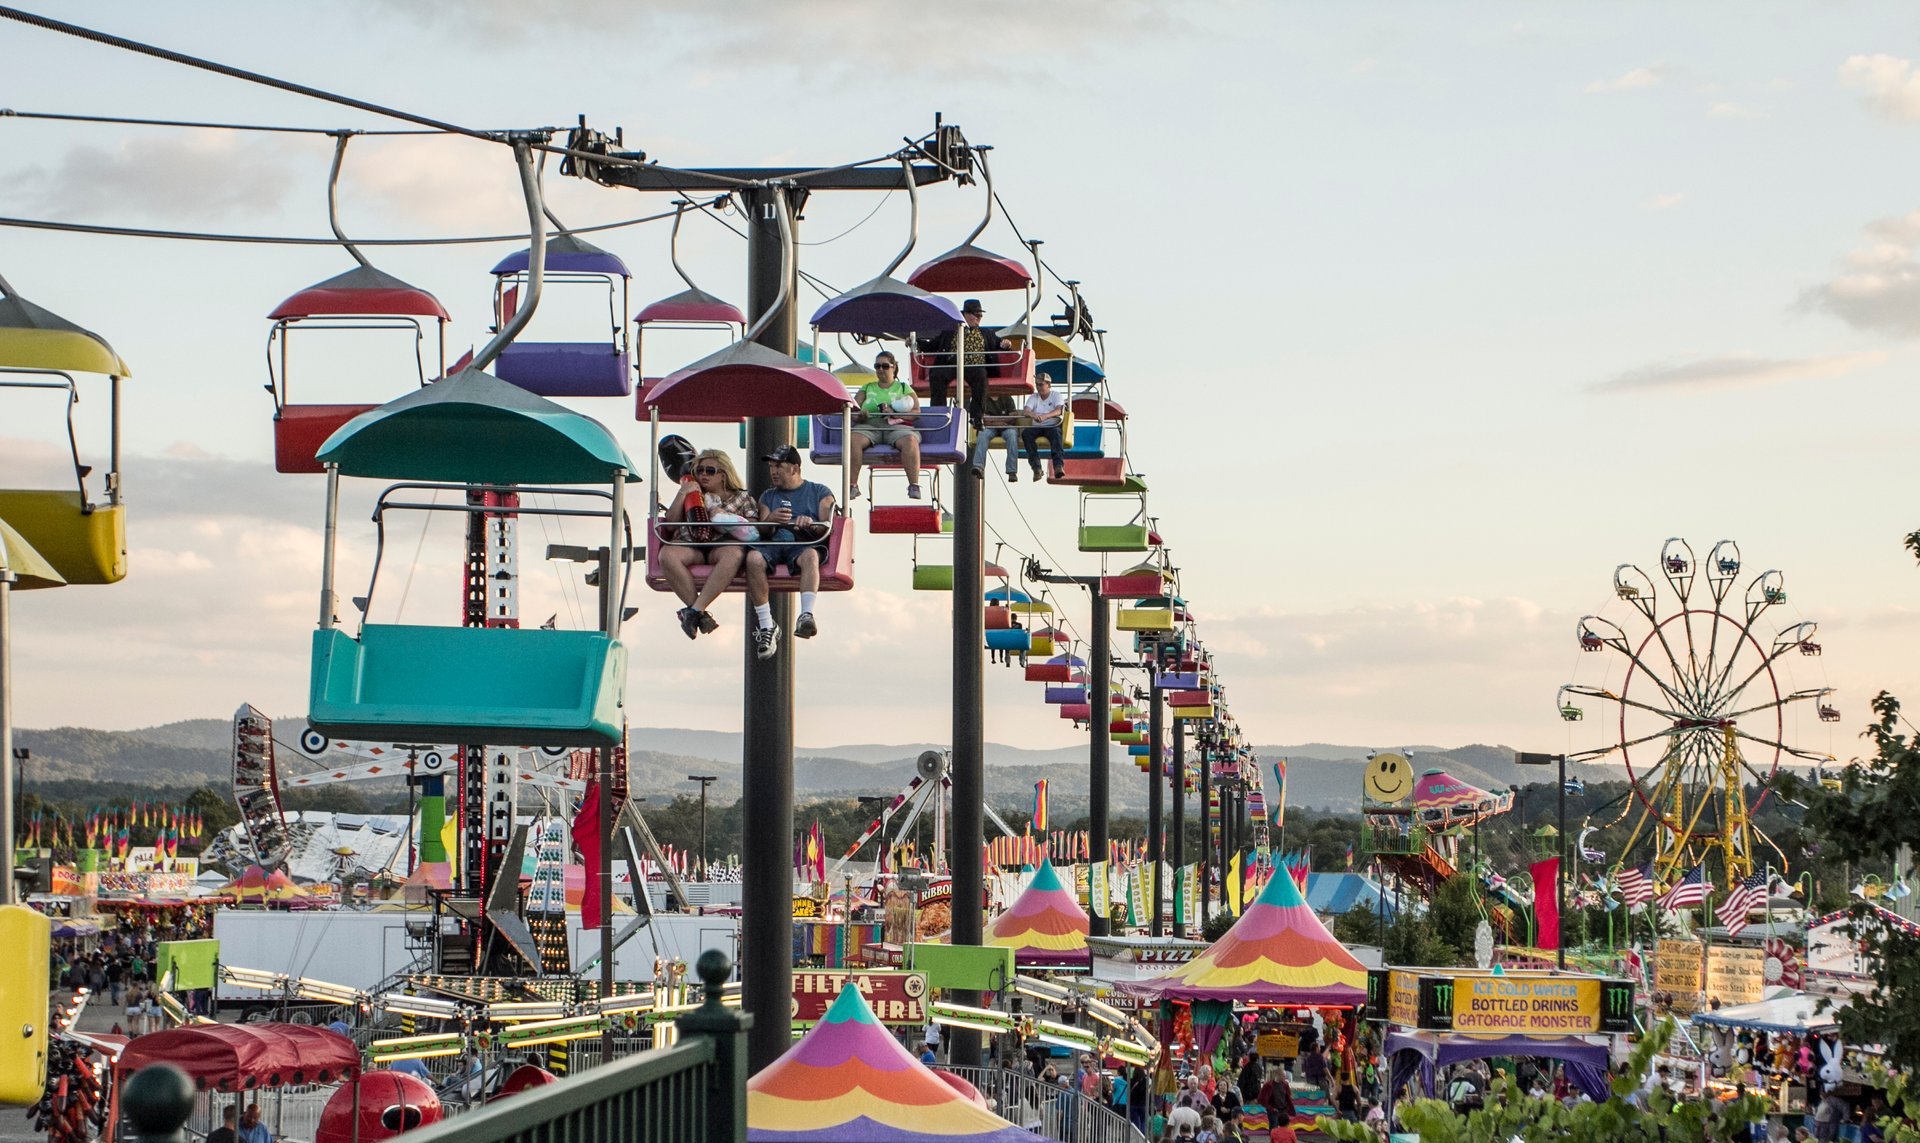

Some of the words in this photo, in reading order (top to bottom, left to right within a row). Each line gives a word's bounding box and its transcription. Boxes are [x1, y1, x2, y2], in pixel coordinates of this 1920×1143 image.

[792, 899, 815, 907] UNNEL
[1141, 949, 1194, 962] PIZZ
[1473, 982, 1494, 995] ICE
[1497, 983, 1530, 996] COLD
[1533, 984, 1577, 997] WATER
[1472, 998, 1528, 1011] BOTTLED
[1532, 999, 1578, 1012] DRINKS
[1458, 1013, 1527, 1027] GATORADE
[1530, 1015, 1592, 1028] MONSTER
